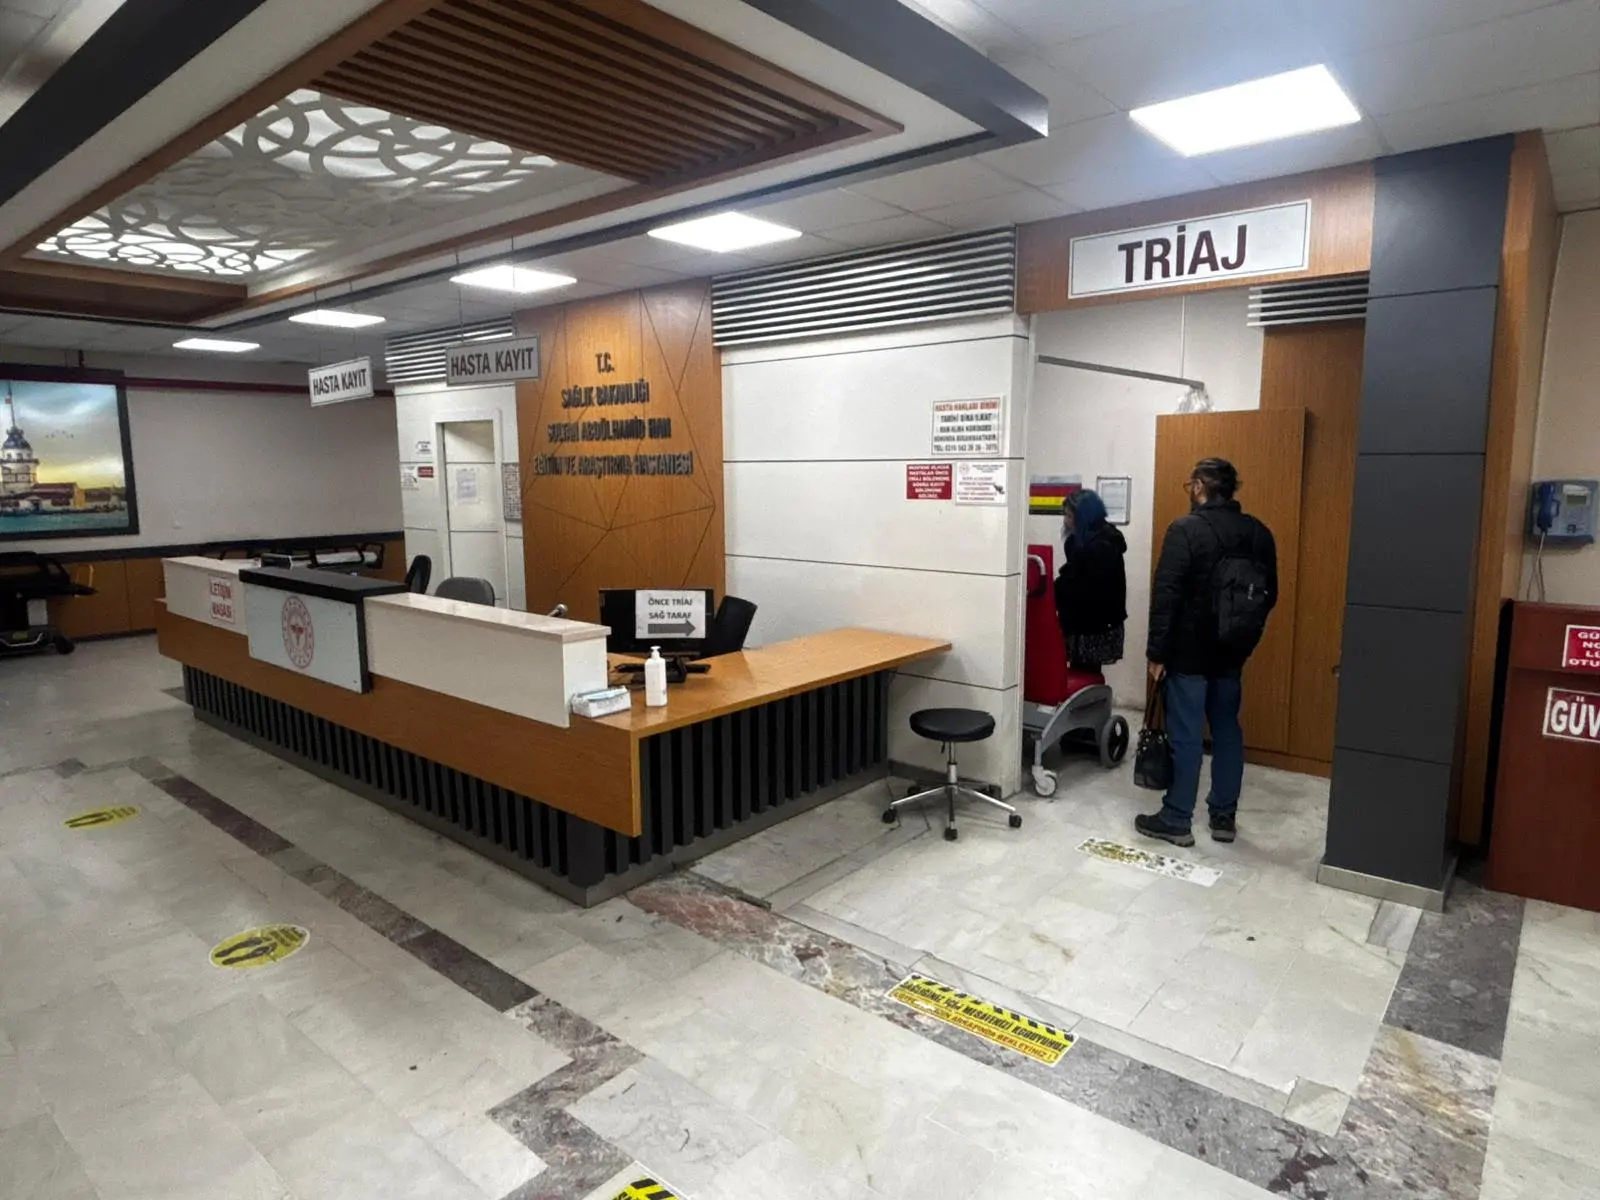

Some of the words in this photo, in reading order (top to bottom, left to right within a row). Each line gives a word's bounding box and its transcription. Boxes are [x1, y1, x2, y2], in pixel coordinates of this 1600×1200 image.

[1118, 224, 1247, 283] TRİAJ
[451, 352, 492, 377] HASTA
[495, 347, 534, 373] KAYIT
[595, 352, 615, 373] T.C.
[313, 373, 340, 396] HASTA
[341, 368, 368, 391] KAYIT
[561, 385, 594, 409] SAĞLIK
[596, 378, 650, 406] BAKANLIĞI
[935, 403, 953, 411] HASTA
[548, 422, 579, 443] SULTAN
[648, 417, 672, 439] HAN
[565, 455, 576, 475] VE
[579, 455, 632, 478] ARAŞTIRMA
[635, 451, 693, 475] HASTANESİ
[648, 597, 669, 606] ÖNCE
[672, 597, 693, 606] TRİAJ
[649, 610, 665, 619] SAĞ
[1013, 1023, 1068, 1052] KORUYUNUZ
